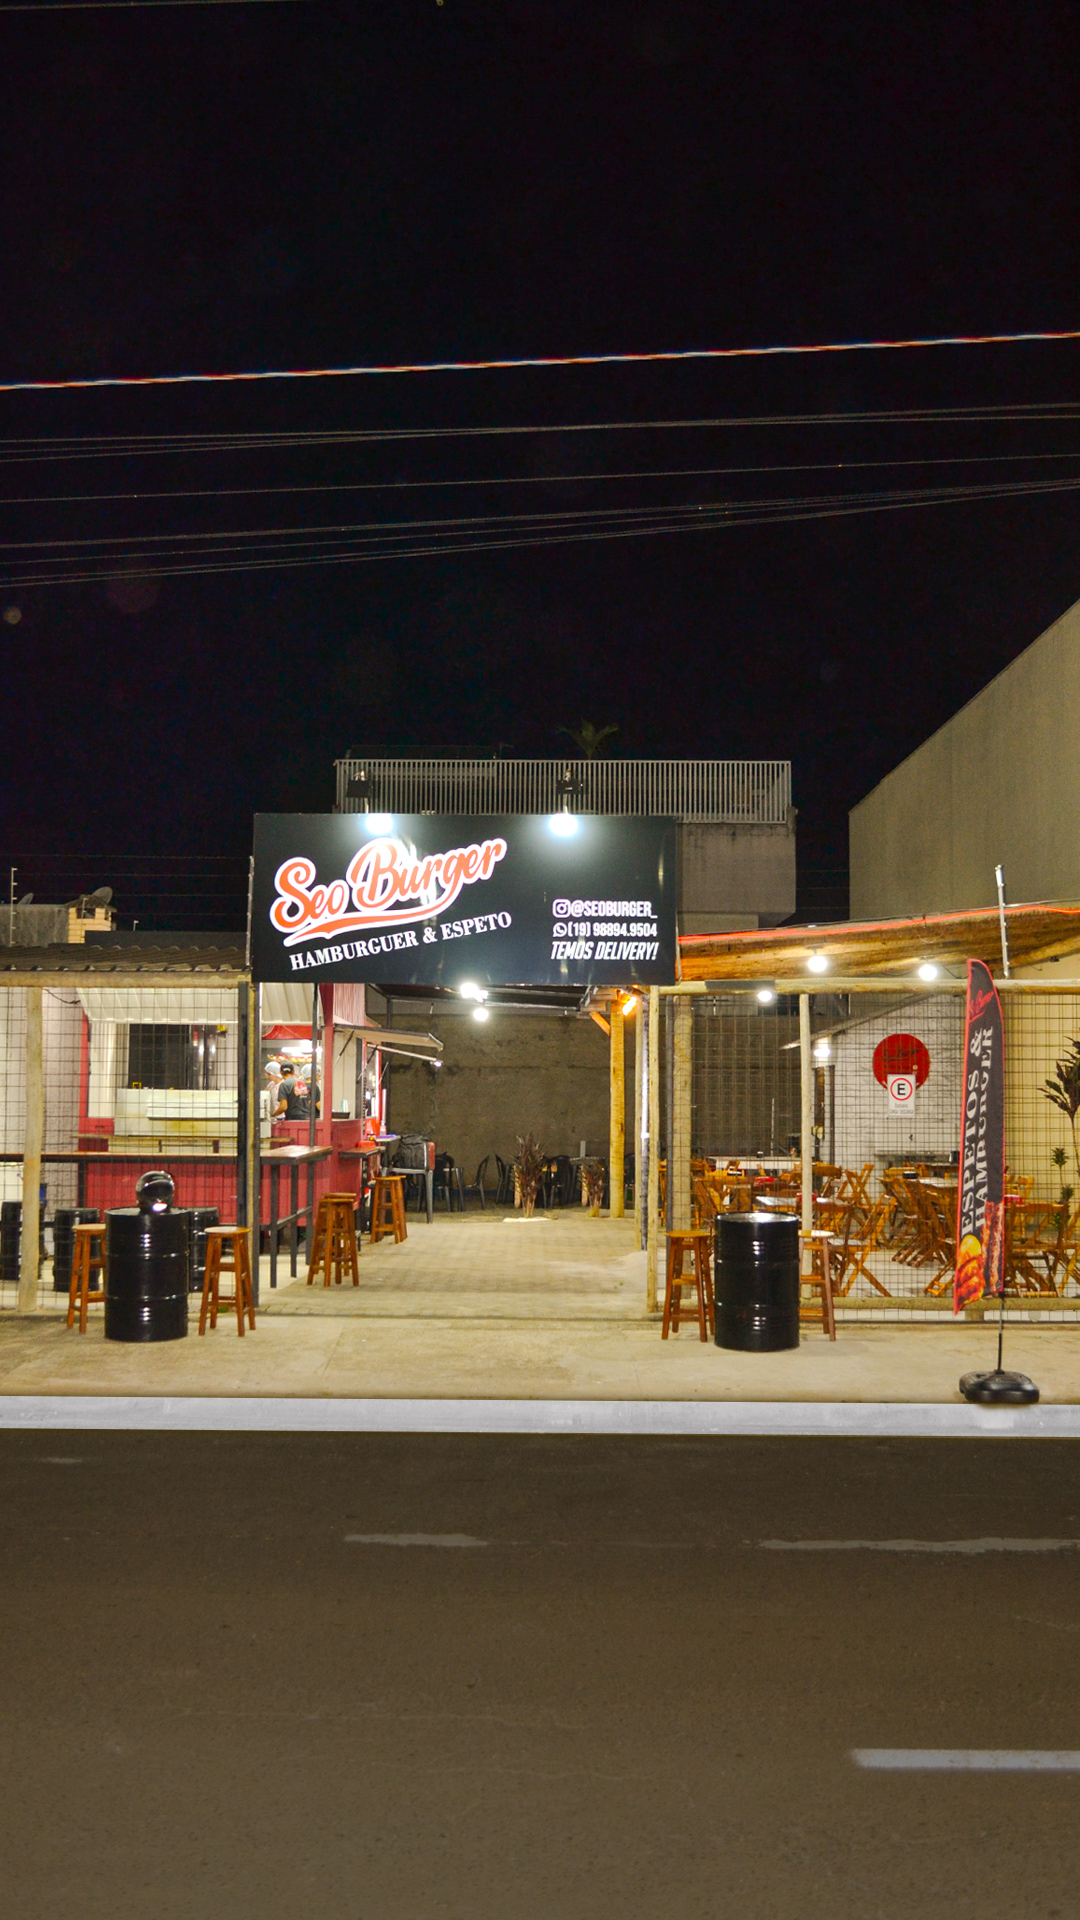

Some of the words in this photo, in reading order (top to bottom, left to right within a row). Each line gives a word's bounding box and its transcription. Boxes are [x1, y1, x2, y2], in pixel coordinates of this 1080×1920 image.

[270, 857, 349, 933] Seo
[346, 837, 507, 913] Burger
[289, 930, 419, 971] HAMBURGUER
[422, 927, 438, 944] &
[440, 911, 512, 940] ESPETO
[567, 921, 591, 937] (19)
[593, 922, 658, 937] 98894.9504
[551, 941, 594, 960] TEMOS
[594, 941, 659, 961] DELIVERY!
[970, 1027, 983, 1057] &
[897, 1083, 906, 1096] E
[961, 1070, 980, 1239] ESPETOS
